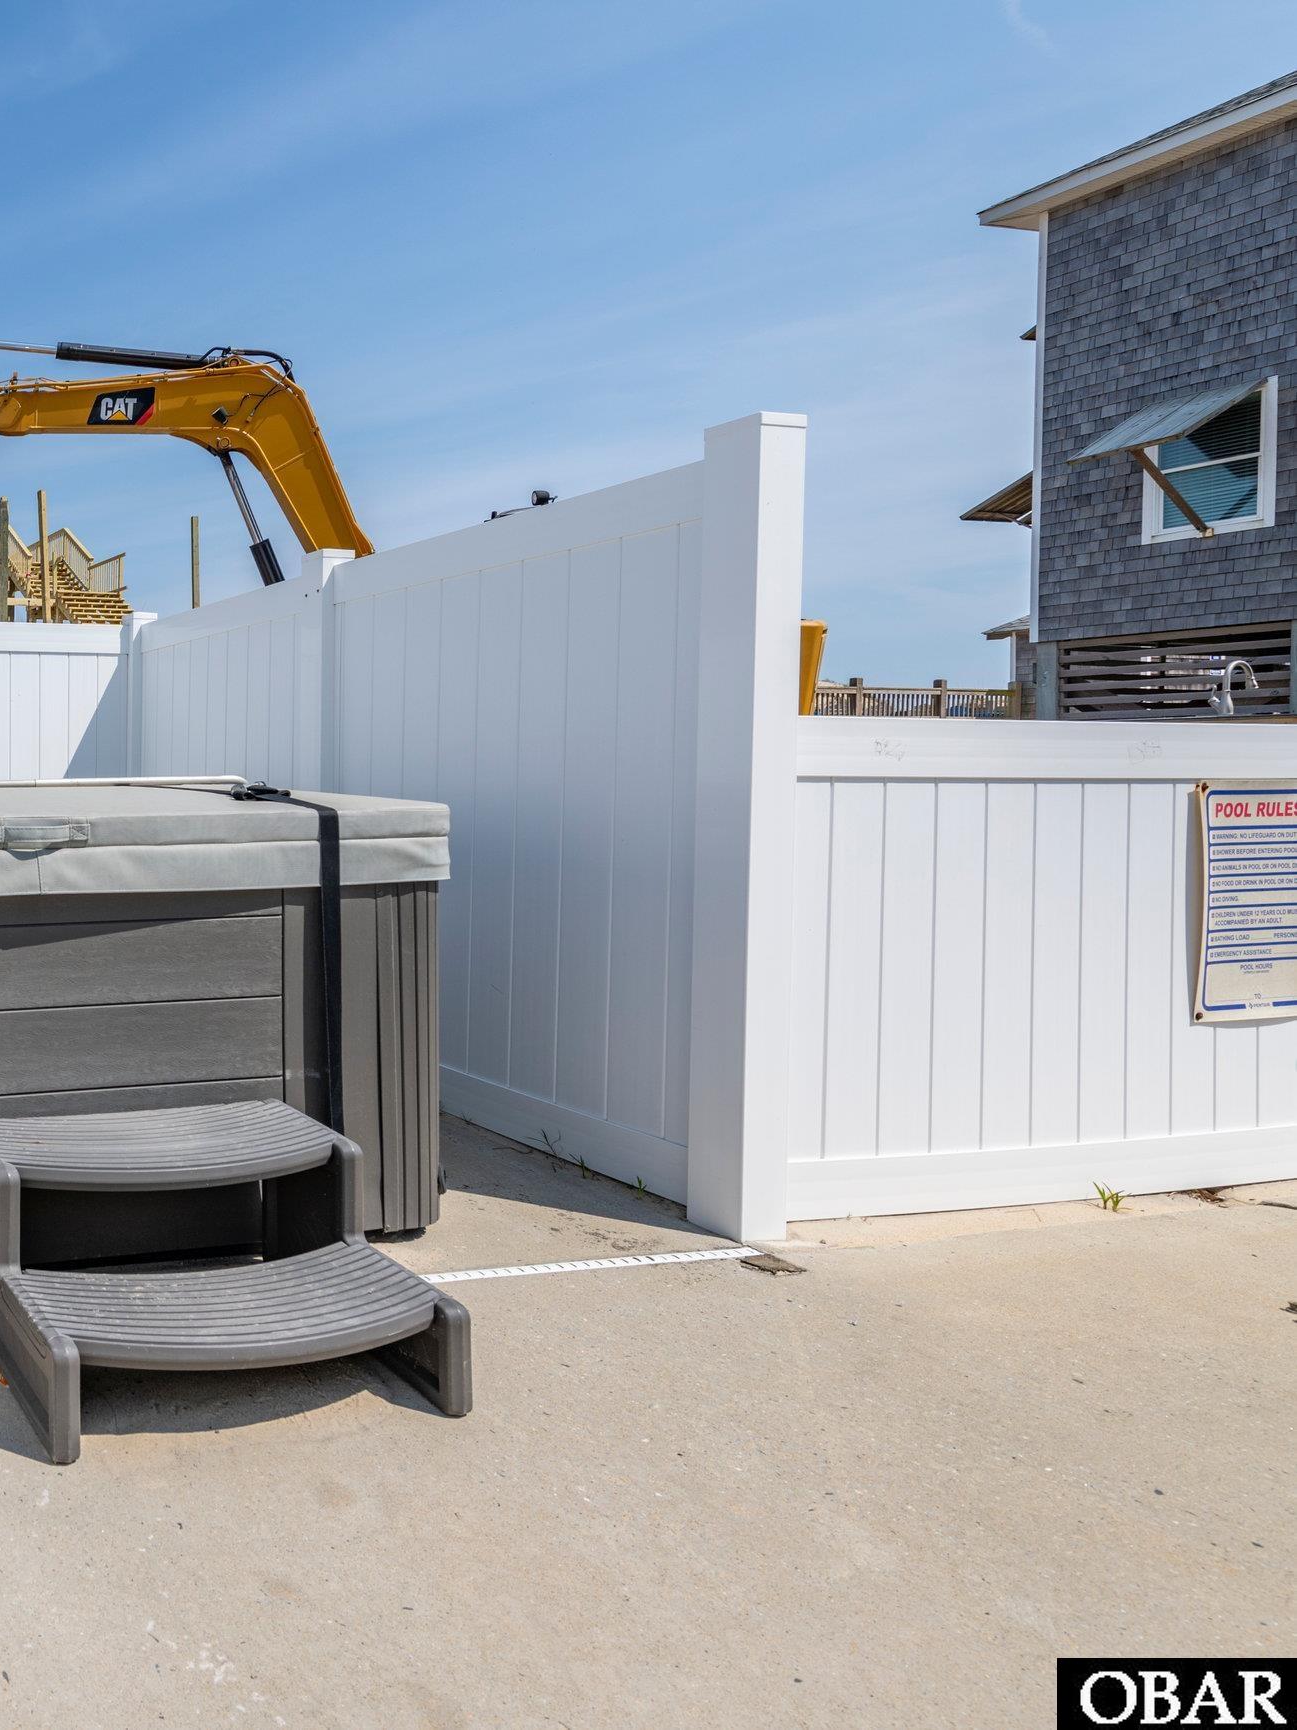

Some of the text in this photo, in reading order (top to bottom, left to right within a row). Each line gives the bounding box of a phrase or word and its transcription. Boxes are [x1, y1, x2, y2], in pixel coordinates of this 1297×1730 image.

[100, 397, 137, 421] CAT
[1215, 802, 1252, 818] POOL
[1214, 950, 1242, 958] EMERGENCY
